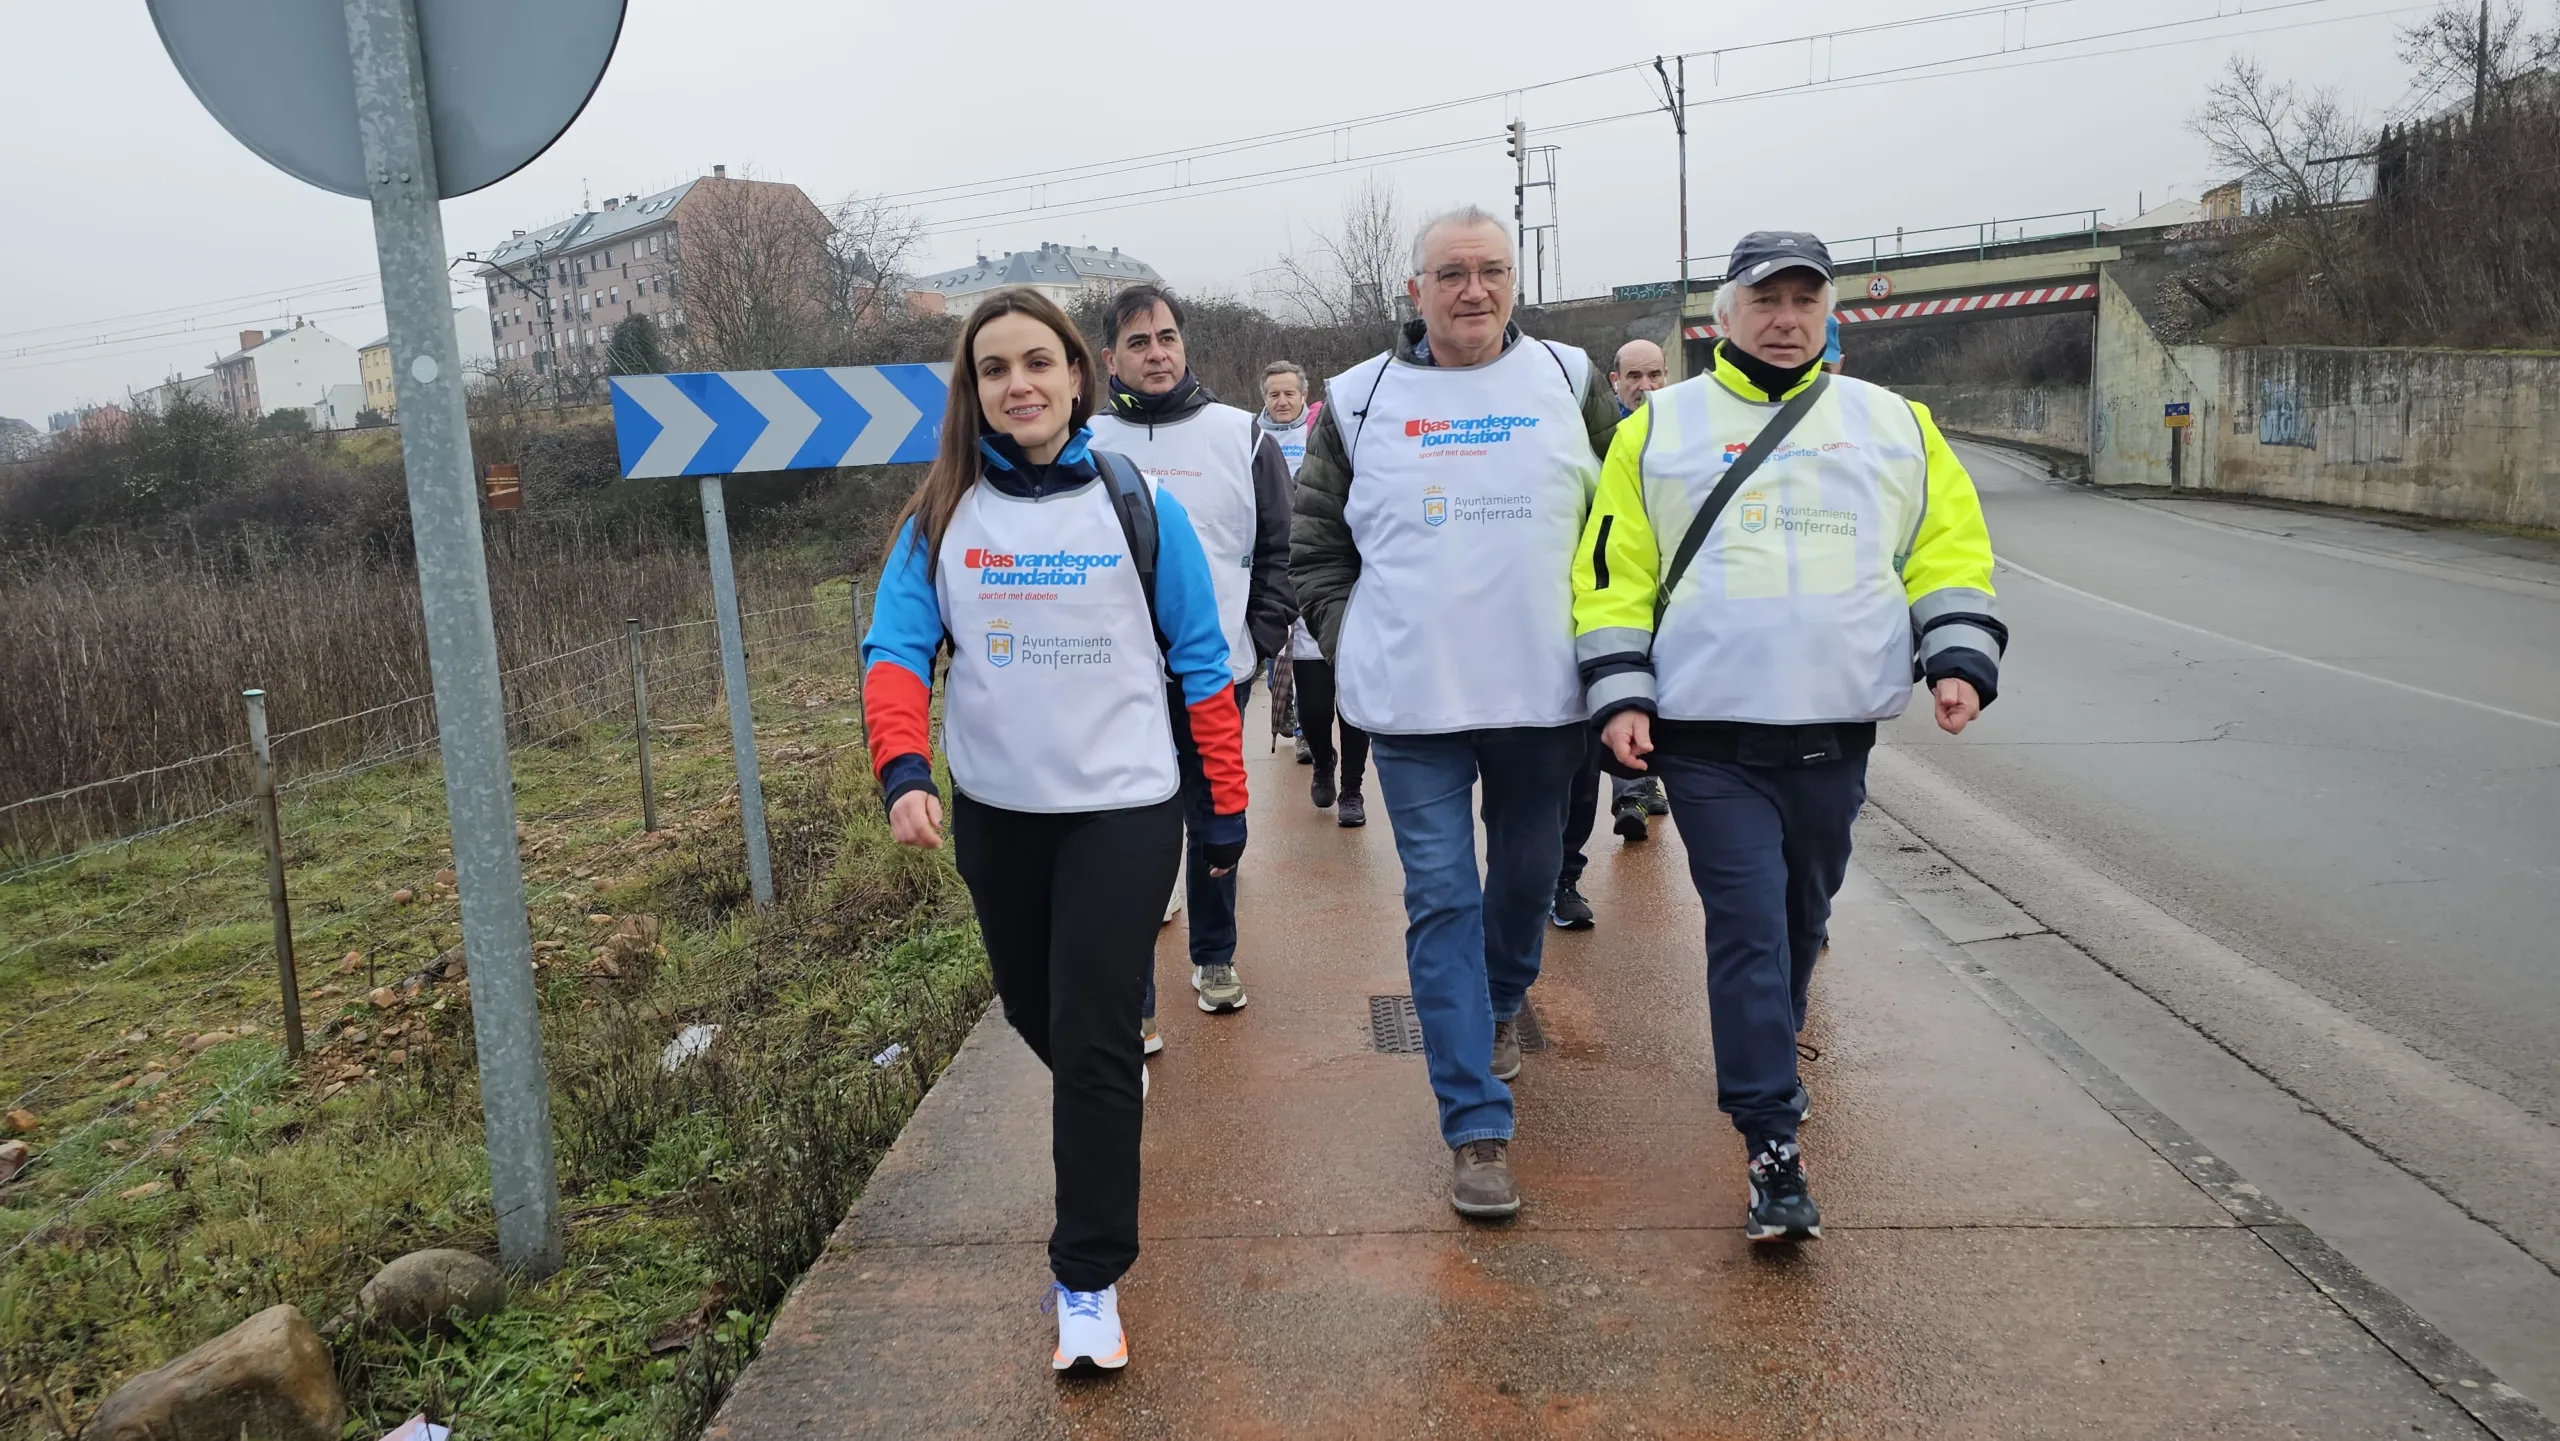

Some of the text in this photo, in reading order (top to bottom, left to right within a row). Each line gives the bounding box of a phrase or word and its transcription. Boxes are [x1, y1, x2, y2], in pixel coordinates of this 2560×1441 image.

[1420, 414, 1540, 435] basvandegoor
[1421, 429, 1511, 448] foundation
[1822, 440, 1860, 452] Camb
[1419, 448, 1487, 459] sportief met diabetes
[1773, 448, 1818, 461] Diabetes
[1150, 468, 1168, 476] Para
[1170, 468, 1202, 477] Cambiar
[1454, 494, 1532, 509] Ayuntamiento
[1454, 506, 1533, 525] Ponferrada
[1775, 504, 1858, 521] Ayuntamiento
[1774, 517, 1857, 537] Ponferrada
[981, 549, 1122, 571] basvandegoor
[980, 567, 1087, 586] foundation
[977, 591, 1059, 601] sportief met diabetes
[1022, 634, 1112, 650] Ayuntamiento
[1022, 649, 1112, 670] Ponferrada
